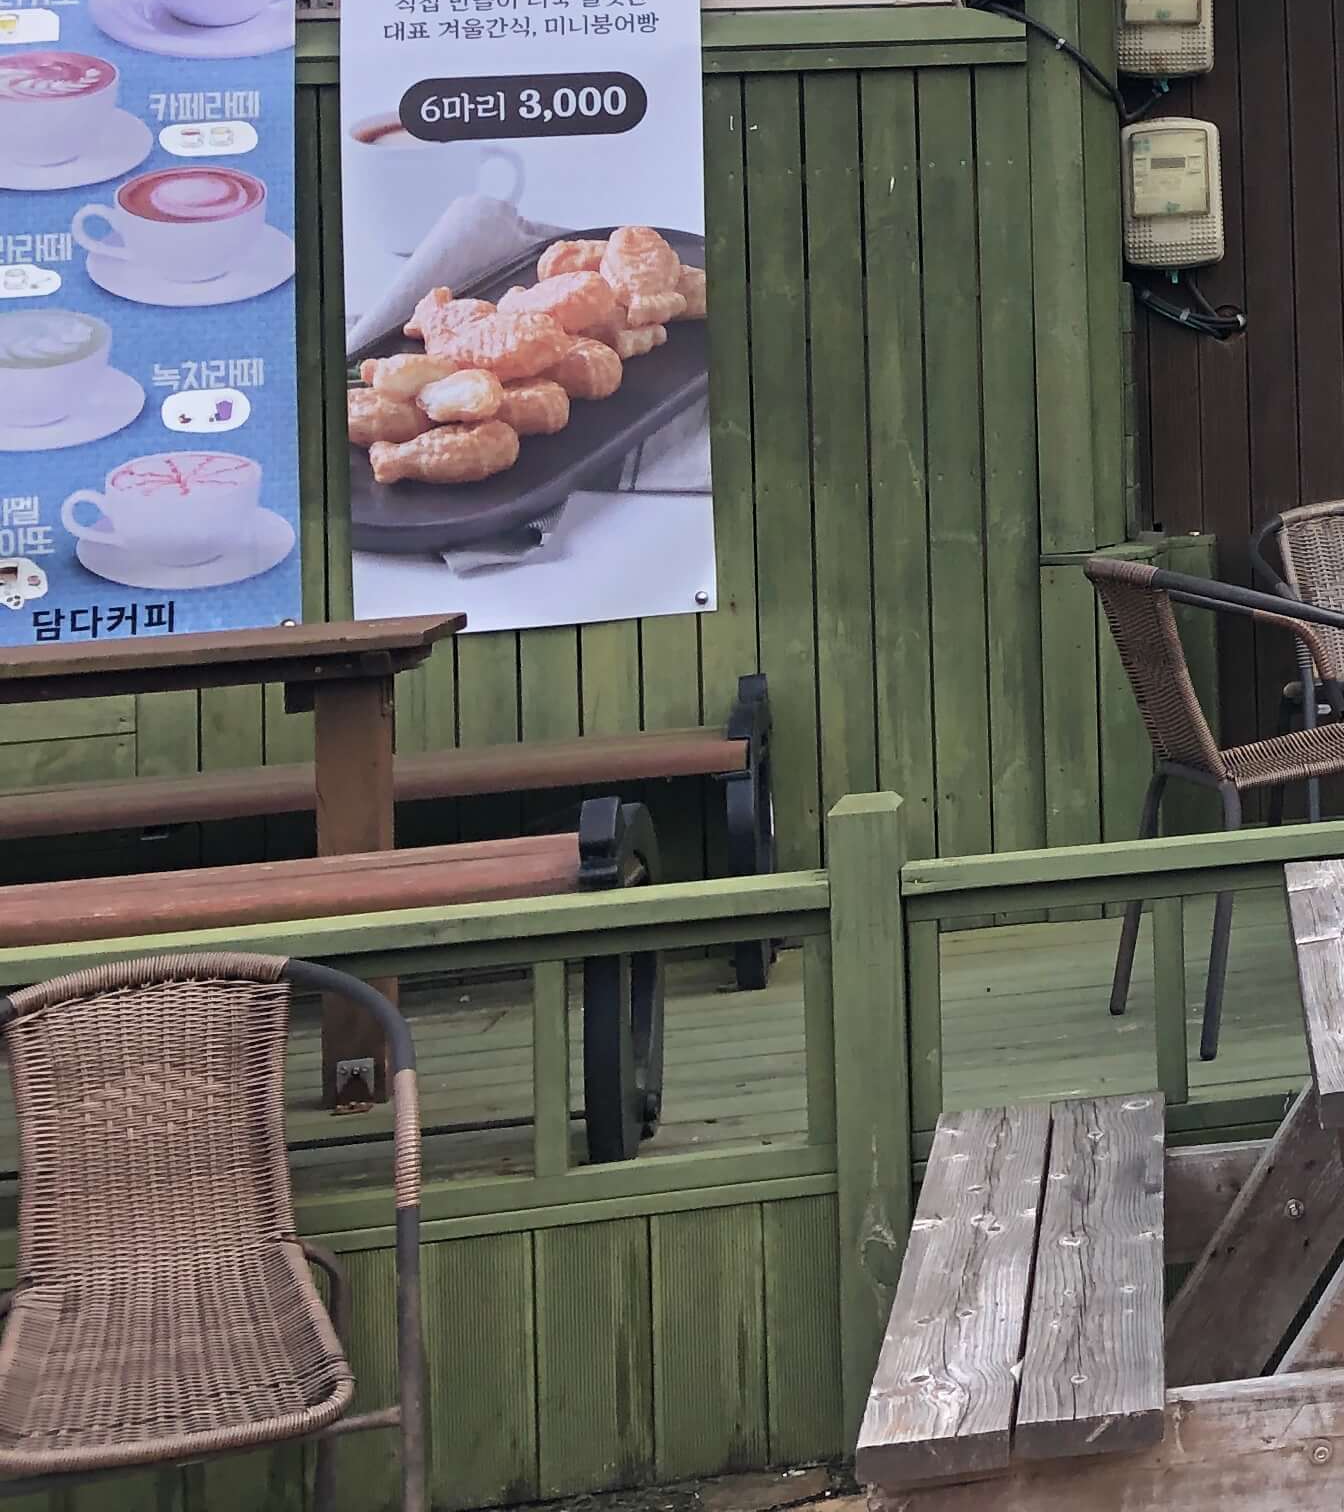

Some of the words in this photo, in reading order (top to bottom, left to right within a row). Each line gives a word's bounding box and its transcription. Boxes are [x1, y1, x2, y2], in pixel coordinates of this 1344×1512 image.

[384, 20, 431, 42] 대표
[438, 16, 537, 39] 겨울간식,
[544, 12, 660, 36] 미니붕어빵
[150, 91, 261, 121] 카페라떼
[420, 92, 506, 123] 6마리
[518, 86, 627, 123] 3,000
[152, 358, 265, 390] 녹차라떼
[32, 601, 175, 641] 담다커피
